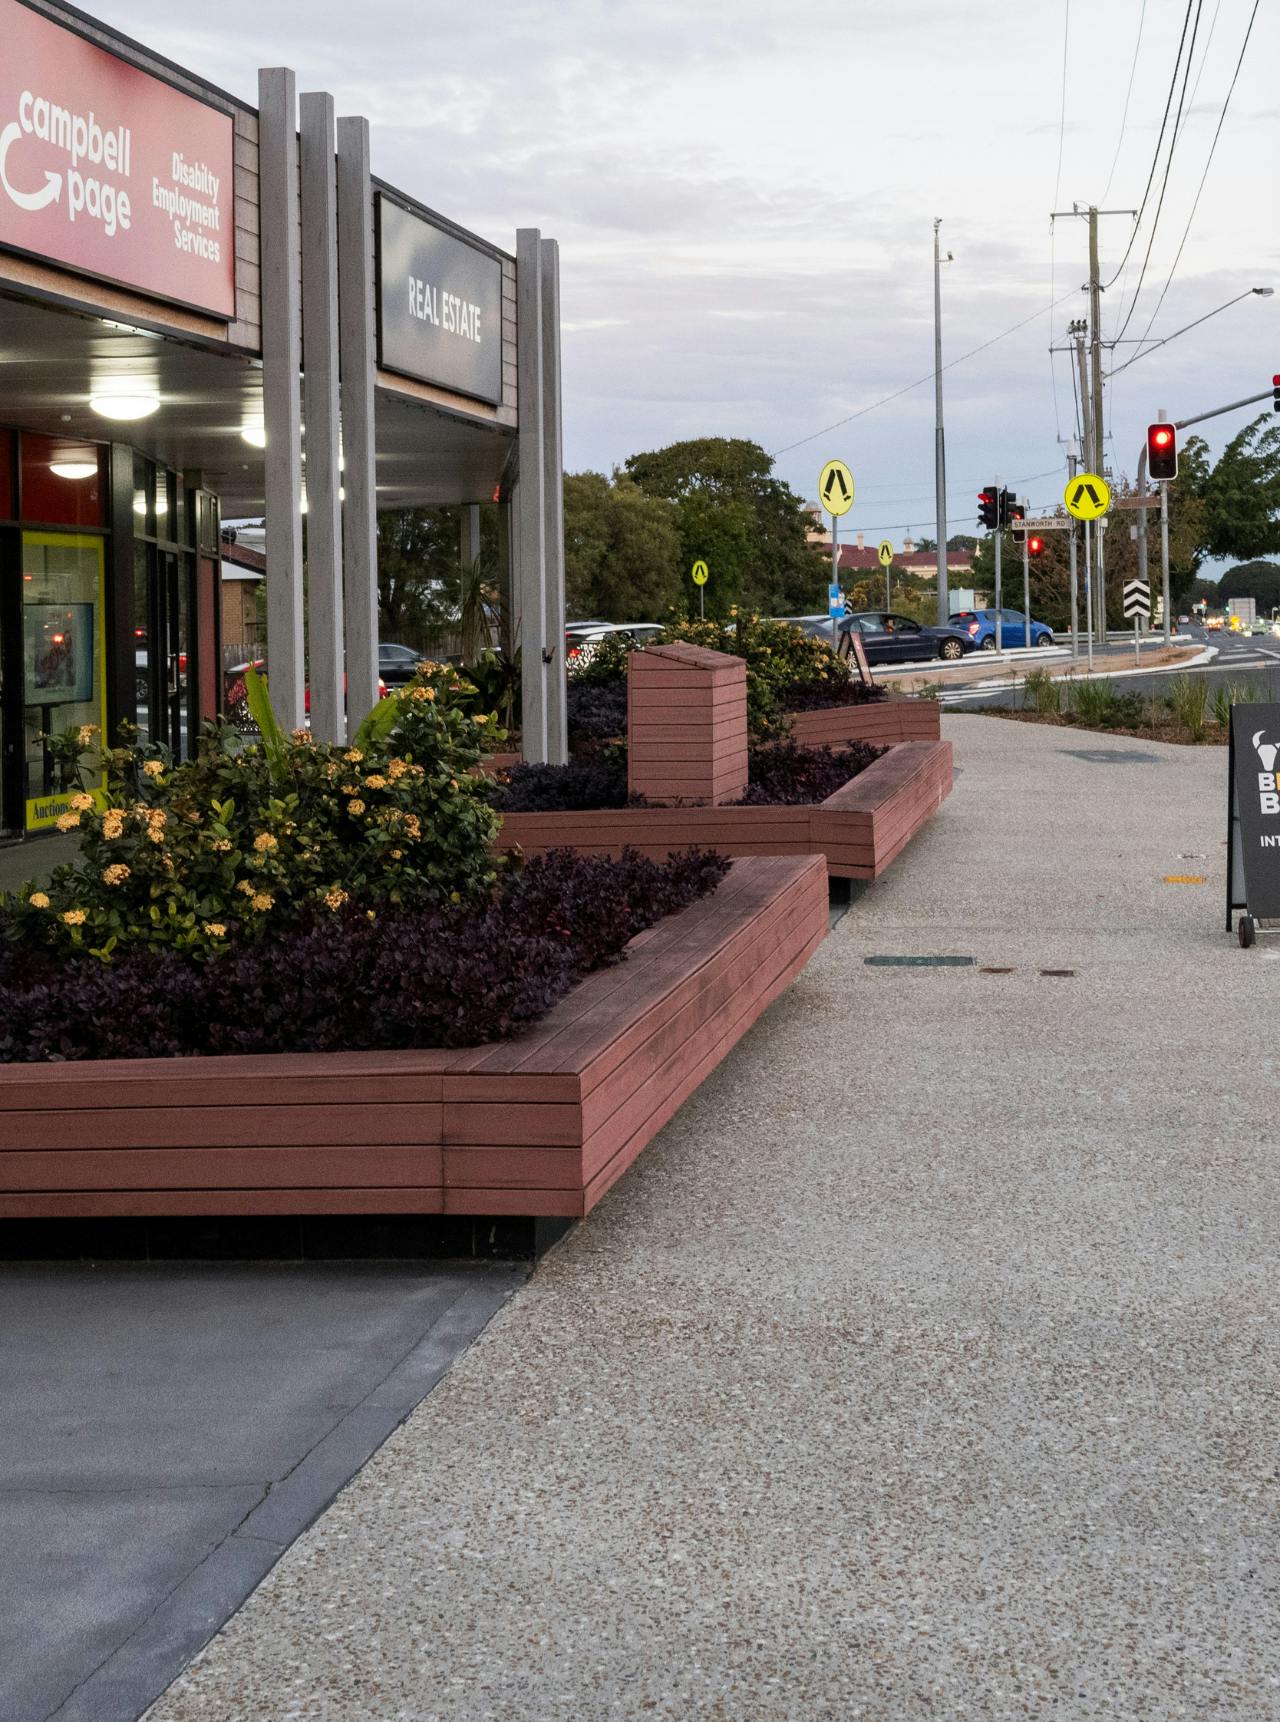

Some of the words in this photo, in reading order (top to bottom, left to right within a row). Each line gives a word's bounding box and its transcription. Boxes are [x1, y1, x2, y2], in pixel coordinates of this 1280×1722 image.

[19, 90, 131, 177] campbell
[67, 168, 131, 237] page
[152, 176, 220, 231] Employment
[174, 219, 220, 263] Services
[408, 275, 440, 326] REAL
[442, 291, 481, 343] ESTATE
